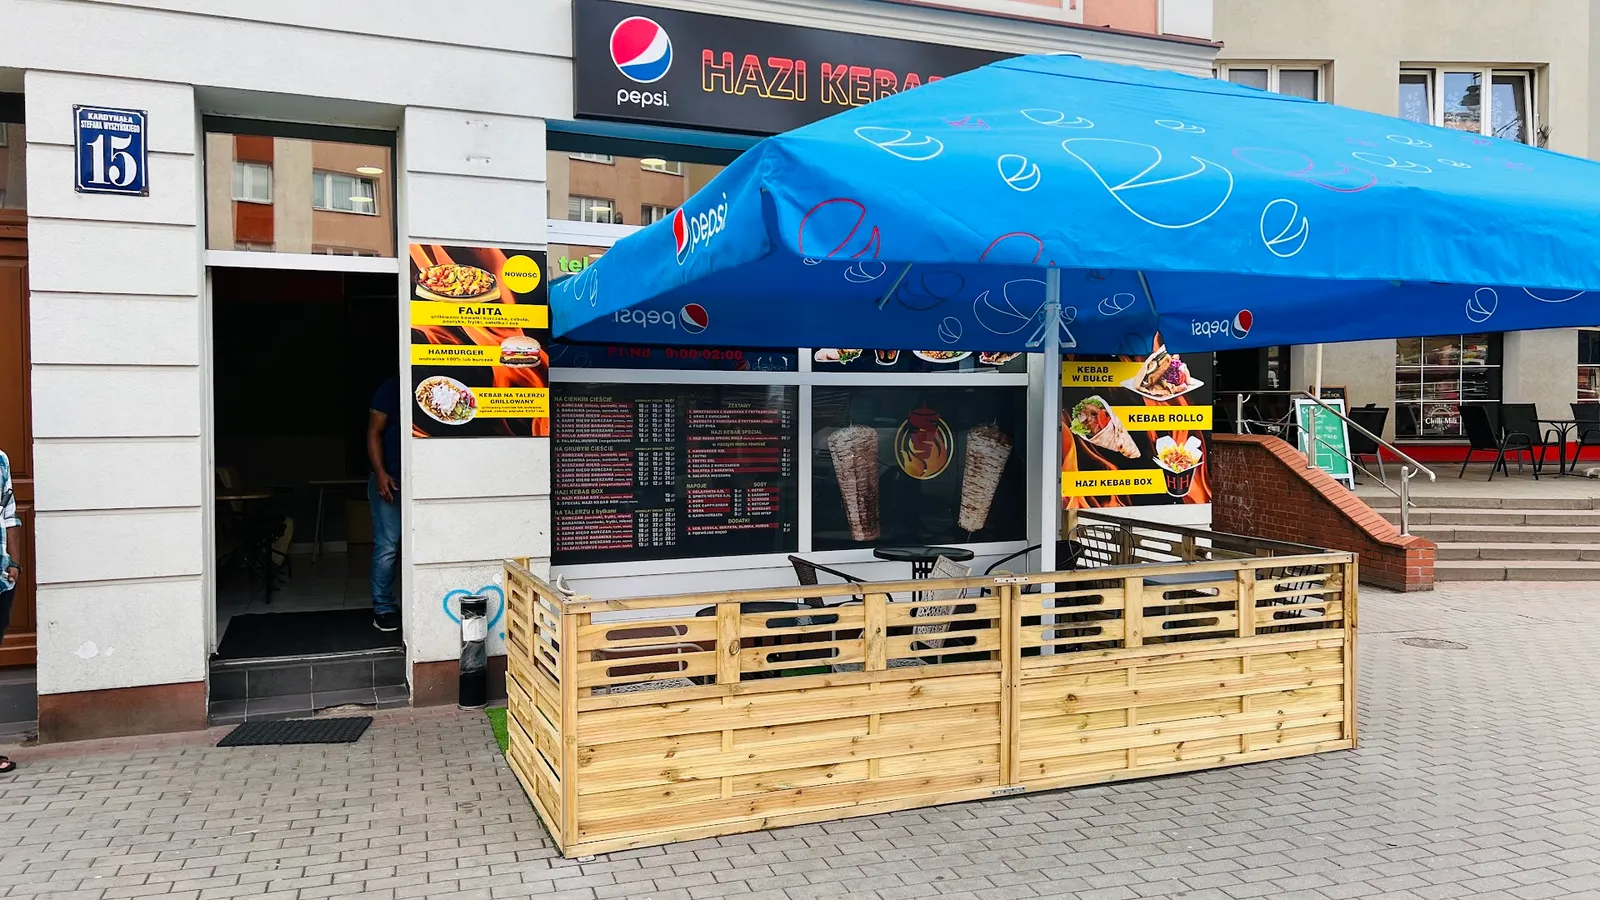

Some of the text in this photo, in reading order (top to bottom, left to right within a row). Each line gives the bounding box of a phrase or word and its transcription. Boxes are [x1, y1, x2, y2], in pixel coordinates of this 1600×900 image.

[702, 49, 946, 107] HAZI KEBA
[88, 113, 133, 123] KARDYNAŁA
[81, 120, 140, 133] STEFANA WYSZYŃSKIEGO
[87, 134, 137, 186] 15
[691, 192, 728, 254] pepsi
[459, 306, 502, 315] FAJITA
[1077, 366, 1109, 374] KEBAB
[1083, 374, 1114, 382] BUŁCE
[1128, 413, 1204, 422] KEBAB ROLLO
[1075, 480, 1097, 488] HAZI
[1133, 478, 1153, 486] BOX
